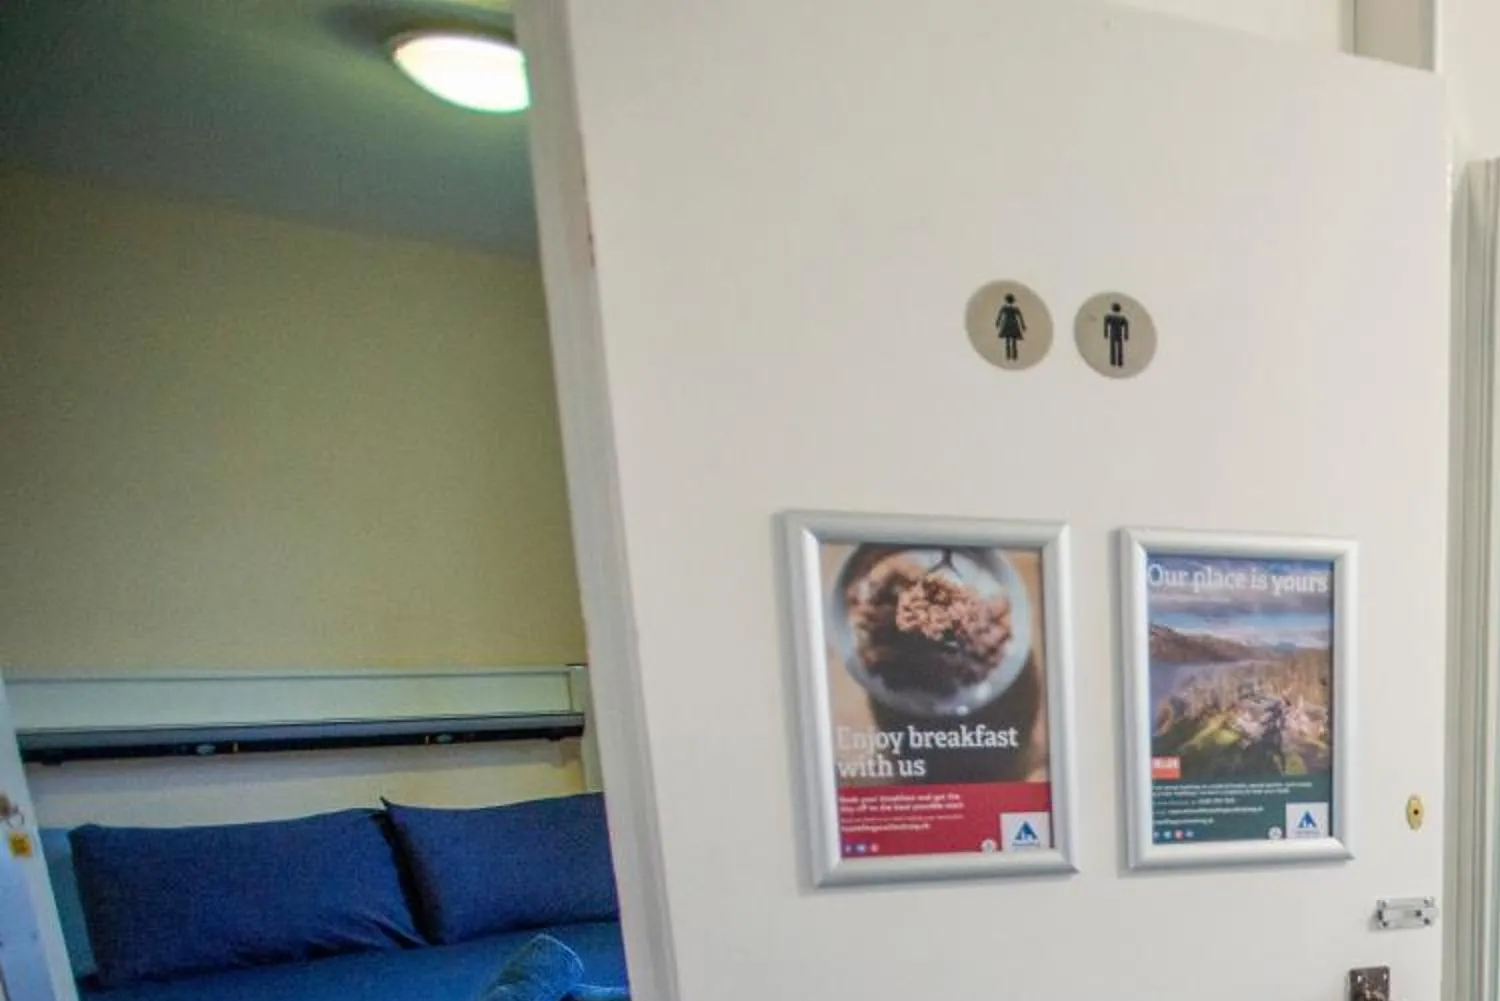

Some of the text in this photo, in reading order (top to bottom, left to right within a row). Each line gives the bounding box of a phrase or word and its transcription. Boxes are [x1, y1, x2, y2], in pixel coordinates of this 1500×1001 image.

[1148, 563, 1329, 597] Our place is yours
[836, 723, 1020, 755] Enjoy breakfast
[838, 754, 927, 778] with us
